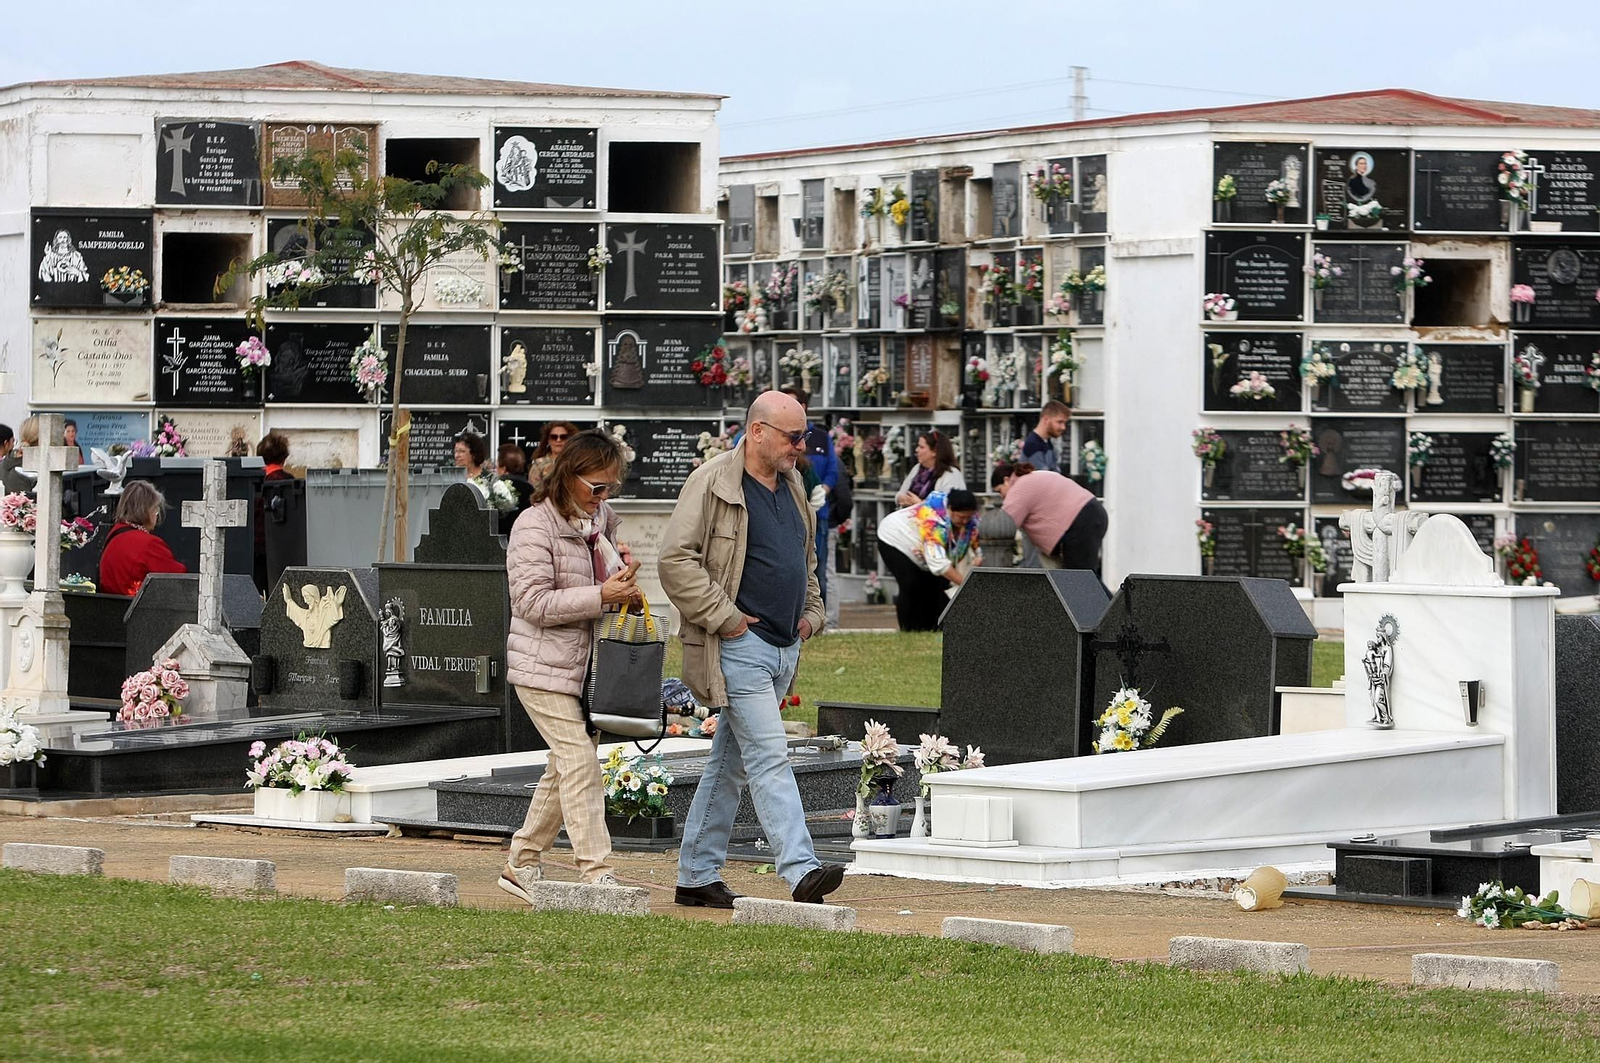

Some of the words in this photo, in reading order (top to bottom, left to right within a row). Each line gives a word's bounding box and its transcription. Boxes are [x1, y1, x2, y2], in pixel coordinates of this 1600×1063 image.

[93, 338, 117, 347] Otilia
[78, 352, 111, 360] Castaño
[113, 352, 133, 360] Dios
[420, 607, 473, 626] FAMILIA
[411, 656, 441, 672] VIDAL
[444, 656, 476, 672] TERUE
